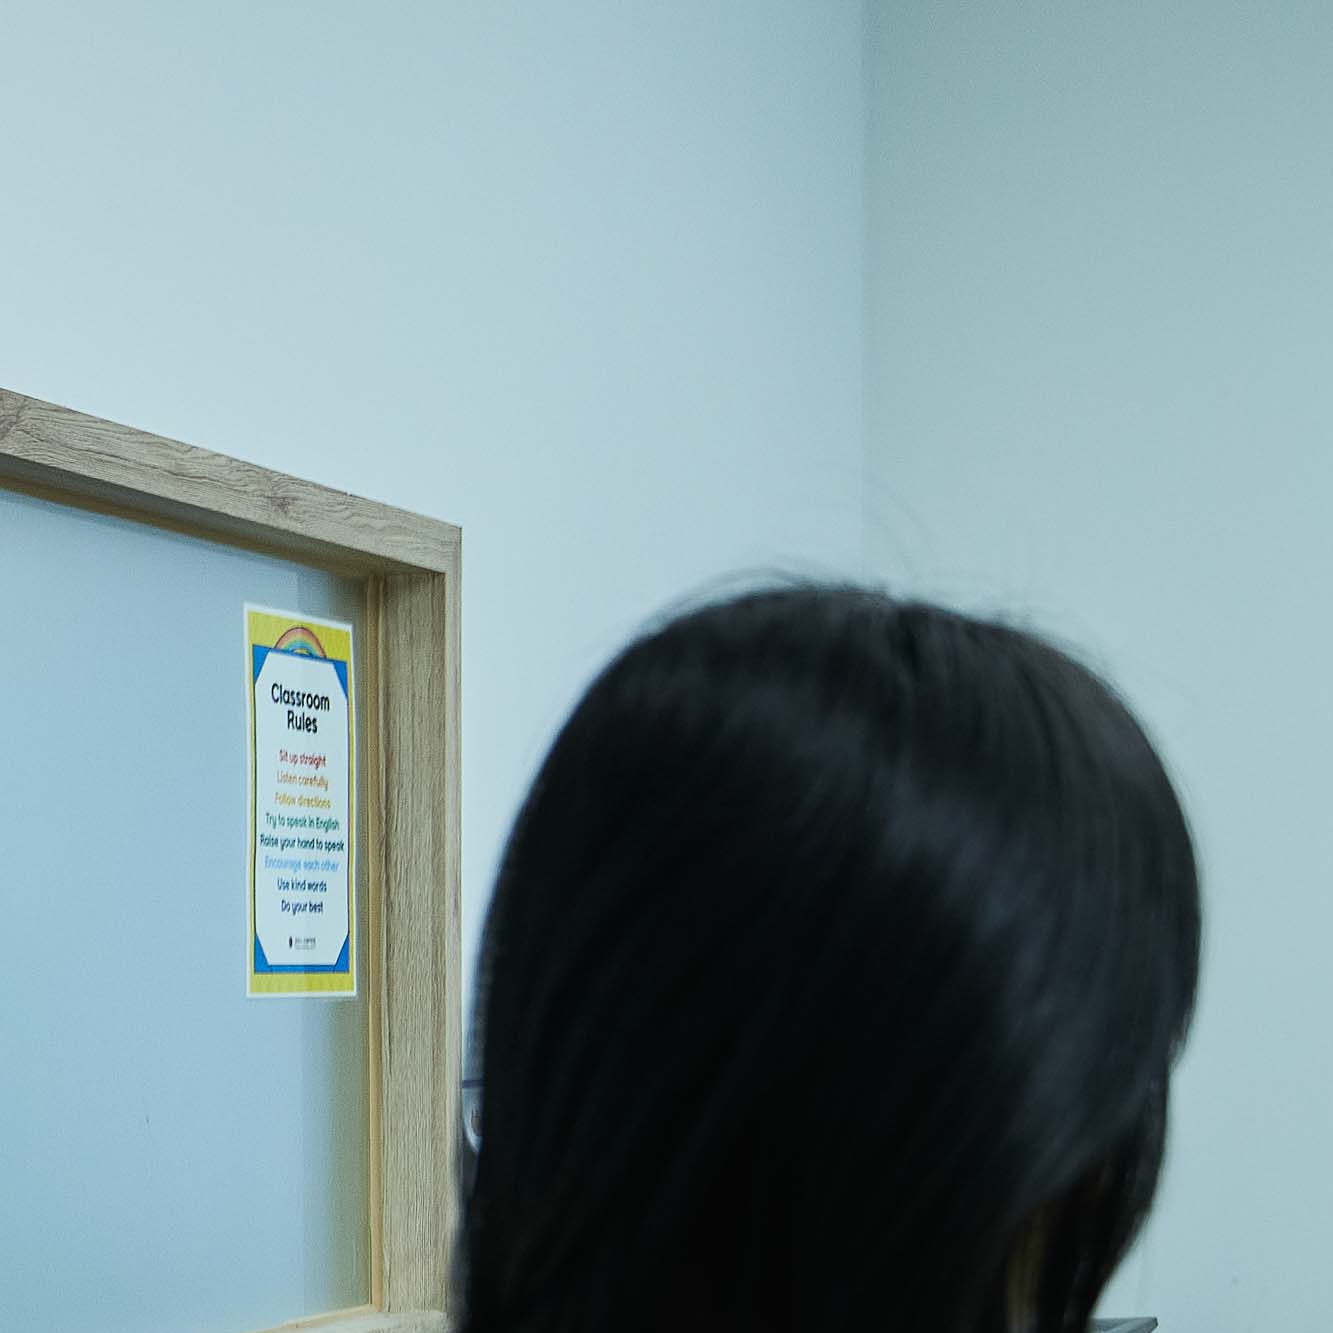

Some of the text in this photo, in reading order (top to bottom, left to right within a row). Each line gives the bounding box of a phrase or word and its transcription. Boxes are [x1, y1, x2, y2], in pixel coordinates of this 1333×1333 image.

[271, 682, 330, 711] Classroom
[287, 710, 318, 734] Rules
[279, 749, 326, 769] Sit up straight
[266, 813, 340, 833] Try to speak in English
[260, 834, 344, 853] Raise your hand to speak
[277, 878, 327, 893] Use kind words
[281, 900, 323, 915] Do your best
